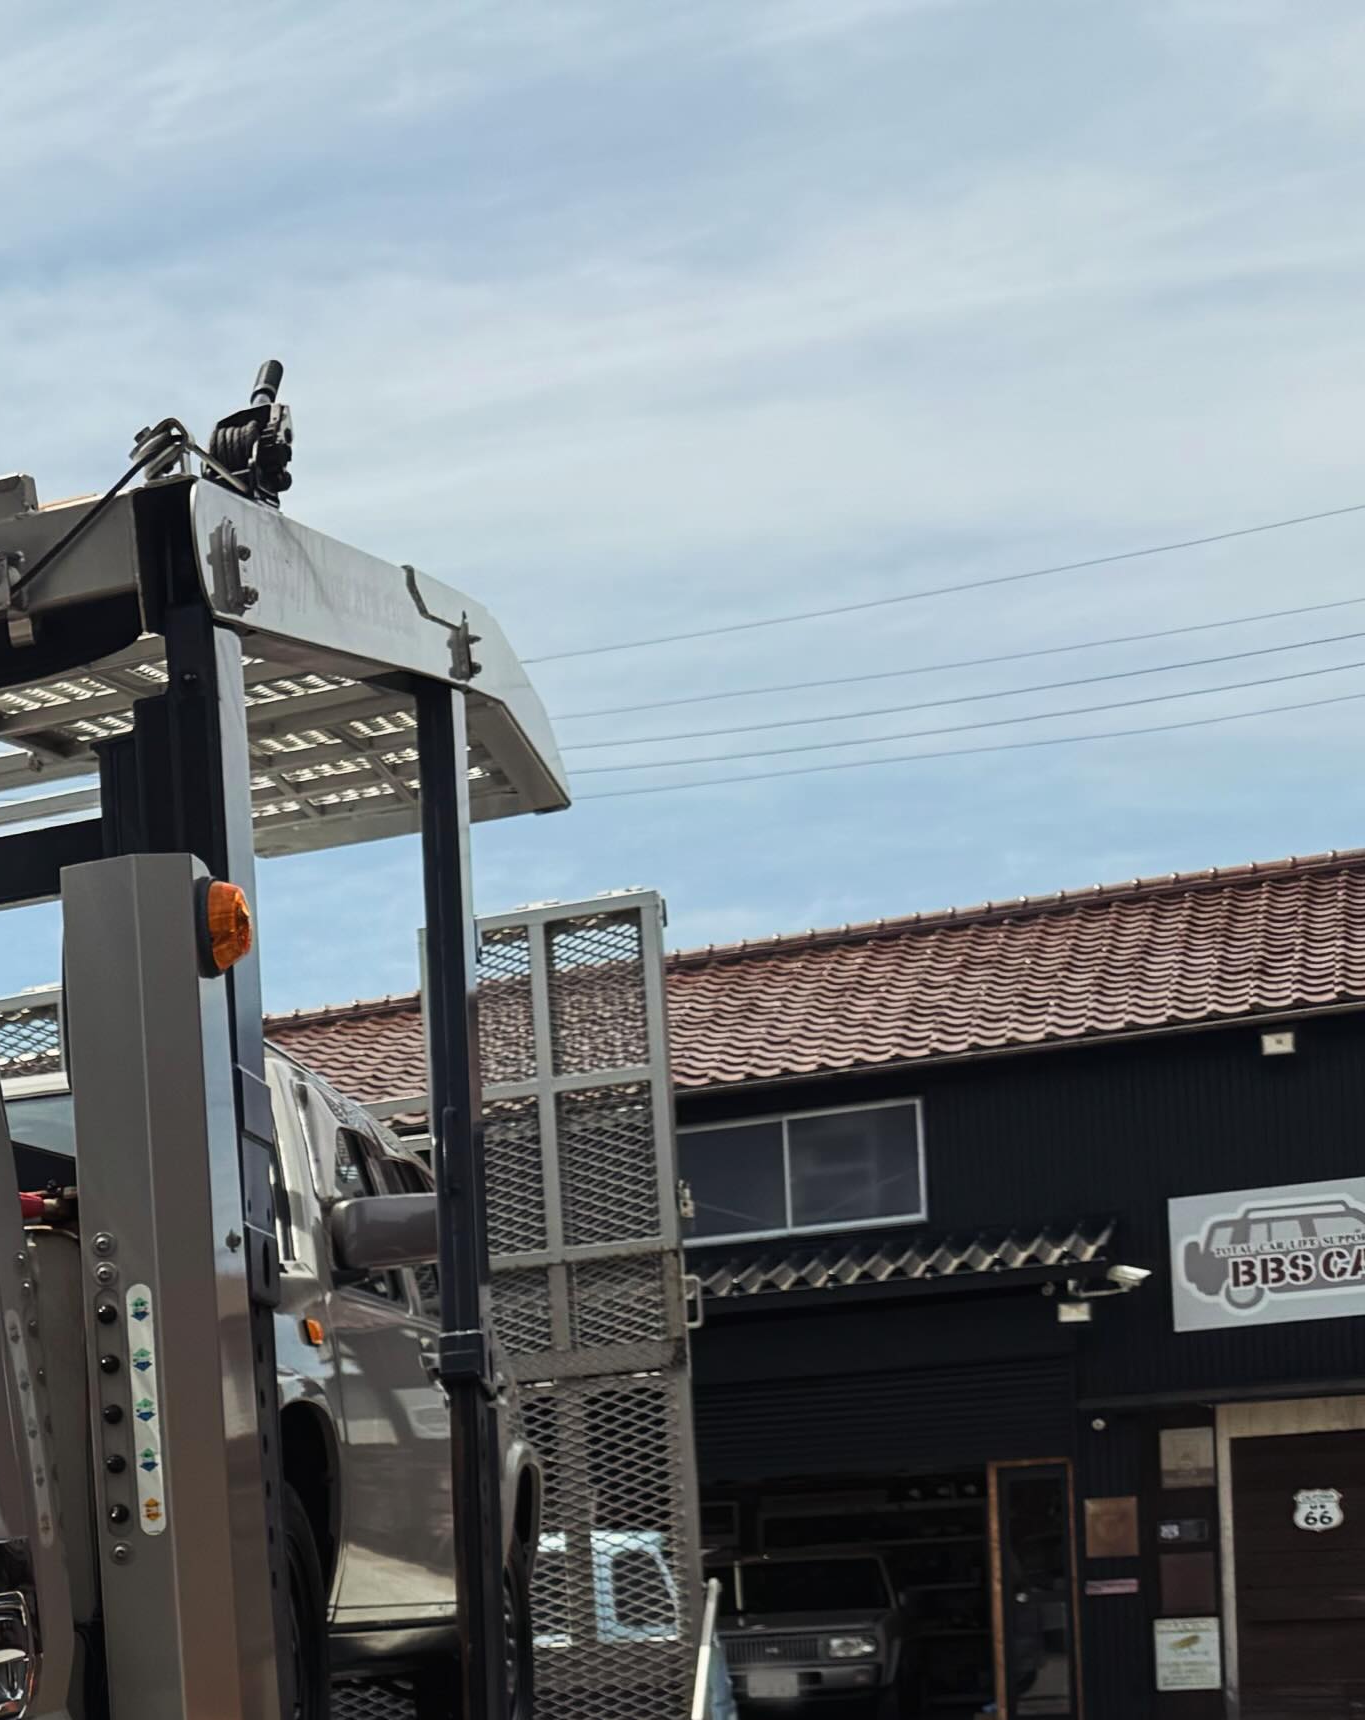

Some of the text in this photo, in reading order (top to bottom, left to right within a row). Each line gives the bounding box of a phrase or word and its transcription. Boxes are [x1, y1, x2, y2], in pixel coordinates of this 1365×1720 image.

[1258, 1240, 1284, 1252] CAR
[1230, 1253, 1314, 1288] BBS
[1304, 1510, 1333, 1525] 66
